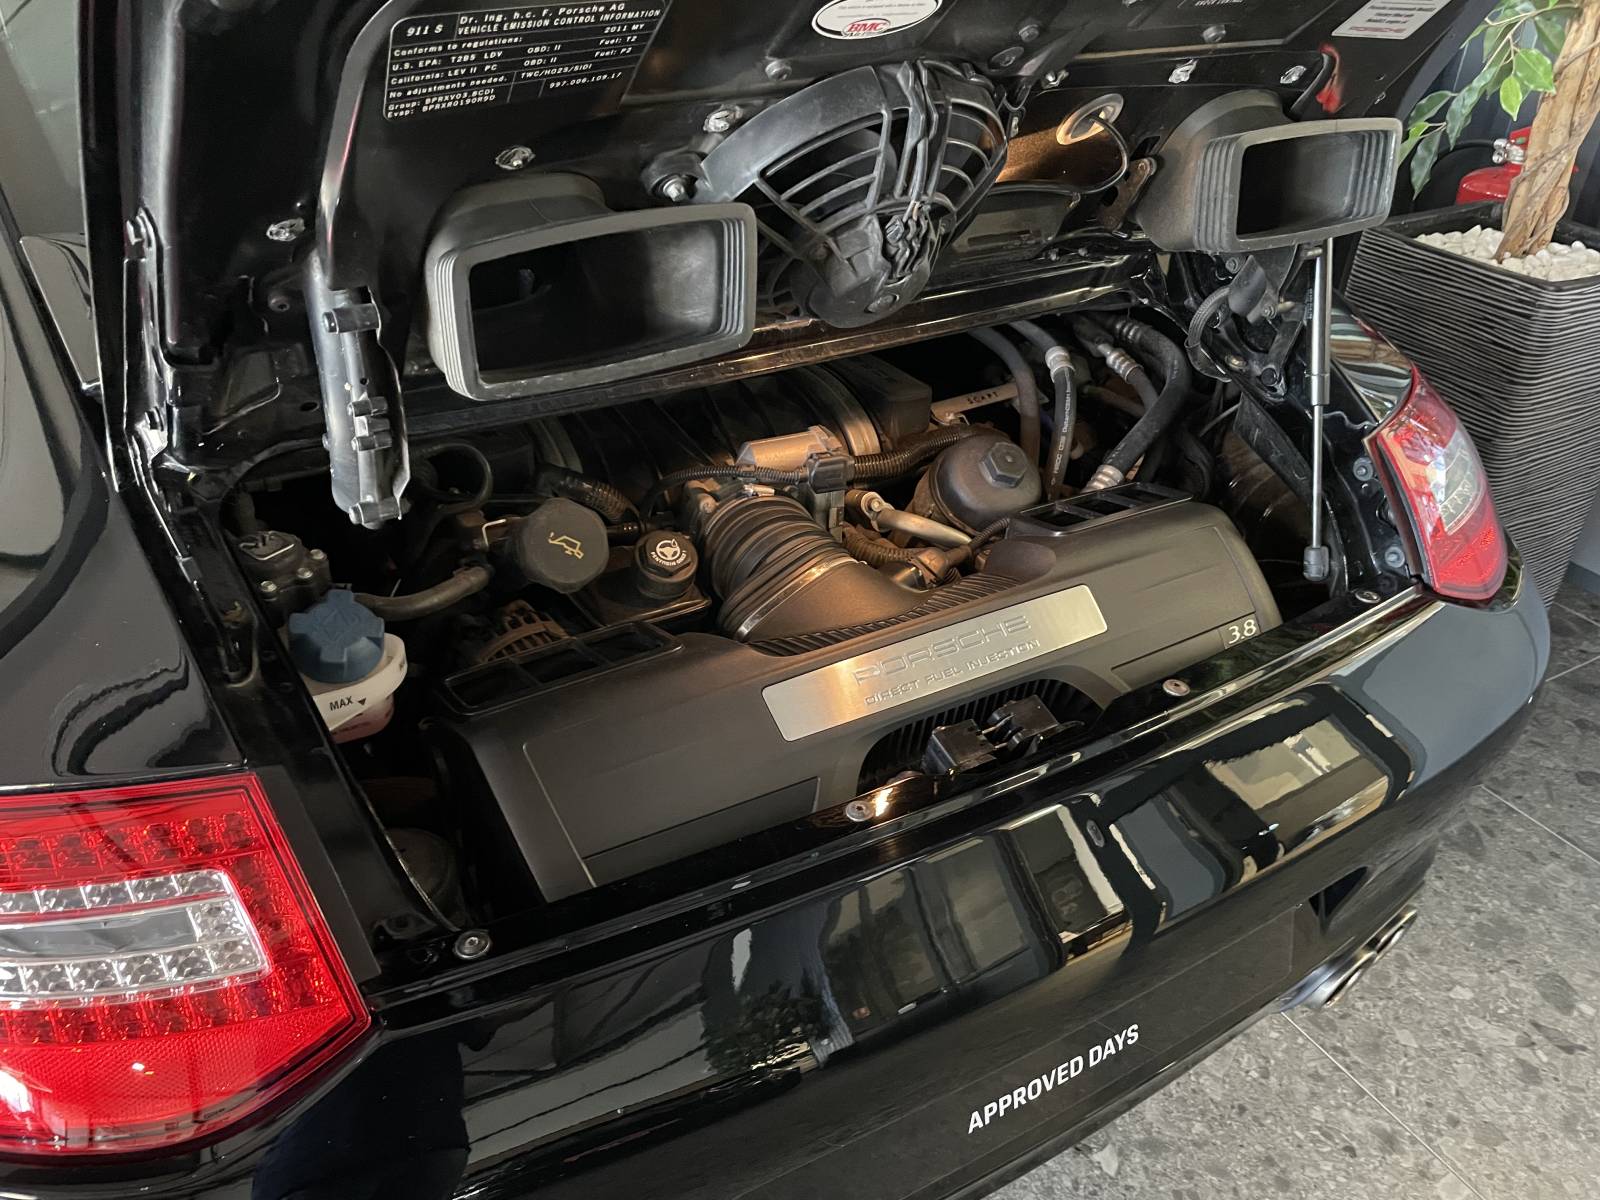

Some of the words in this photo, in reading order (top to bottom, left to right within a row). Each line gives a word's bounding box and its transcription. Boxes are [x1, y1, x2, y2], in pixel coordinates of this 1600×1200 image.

[458, 24, 498, 35] VEHICLE
[503, 19, 550, 31] EMISSION
[554, 15, 596, 26] CONTROL
[600, 10, 661, 22] INFORMATION
[460, 16, 478, 24] Dr.
[485, 14, 507, 22] Ing.
[513, 11, 536, 19] h.c.
[558, 5, 604, 15] Porsche
[609, 3, 626, 11] AG
[394, 45, 443, 56] Conforms
[462, 37, 523, 49] regulations:
[604, 25, 627, 34] 2011
[406, 25, 429, 36] 911
[434, 24, 444, 34] S
[392, 62, 413, 71] U.S.
[418, 58, 441, 68] EPA:
[483, 51, 503, 59] LDV
[527, 45, 550, 54] OBD:
[599, 37, 622, 45] Fuel:
[391, 72, 444, 85] California:
[447, 68, 466, 77] LEV
[470, 66, 477, 74] II
[484, 64, 498, 72] PC
[406, 82, 466, 96] adjustments
[470, 75, 507, 86] needed.
[388, 101, 420, 111] Group:
[388, 109, 414, 118] Evap:
[1228, 619, 1257, 645] 3.8
[853, 615, 1032, 687] PORSCHE
[864, 679, 920, 706] DIRECT
[925, 666, 964, 686] FUEL
[966, 639, 1041, 670] INJECTION
[329, 696, 354, 712] MAX
[968, 1055, 1084, 1135] APPROVED
[1088, 1023, 1140, 1068] DAYS
